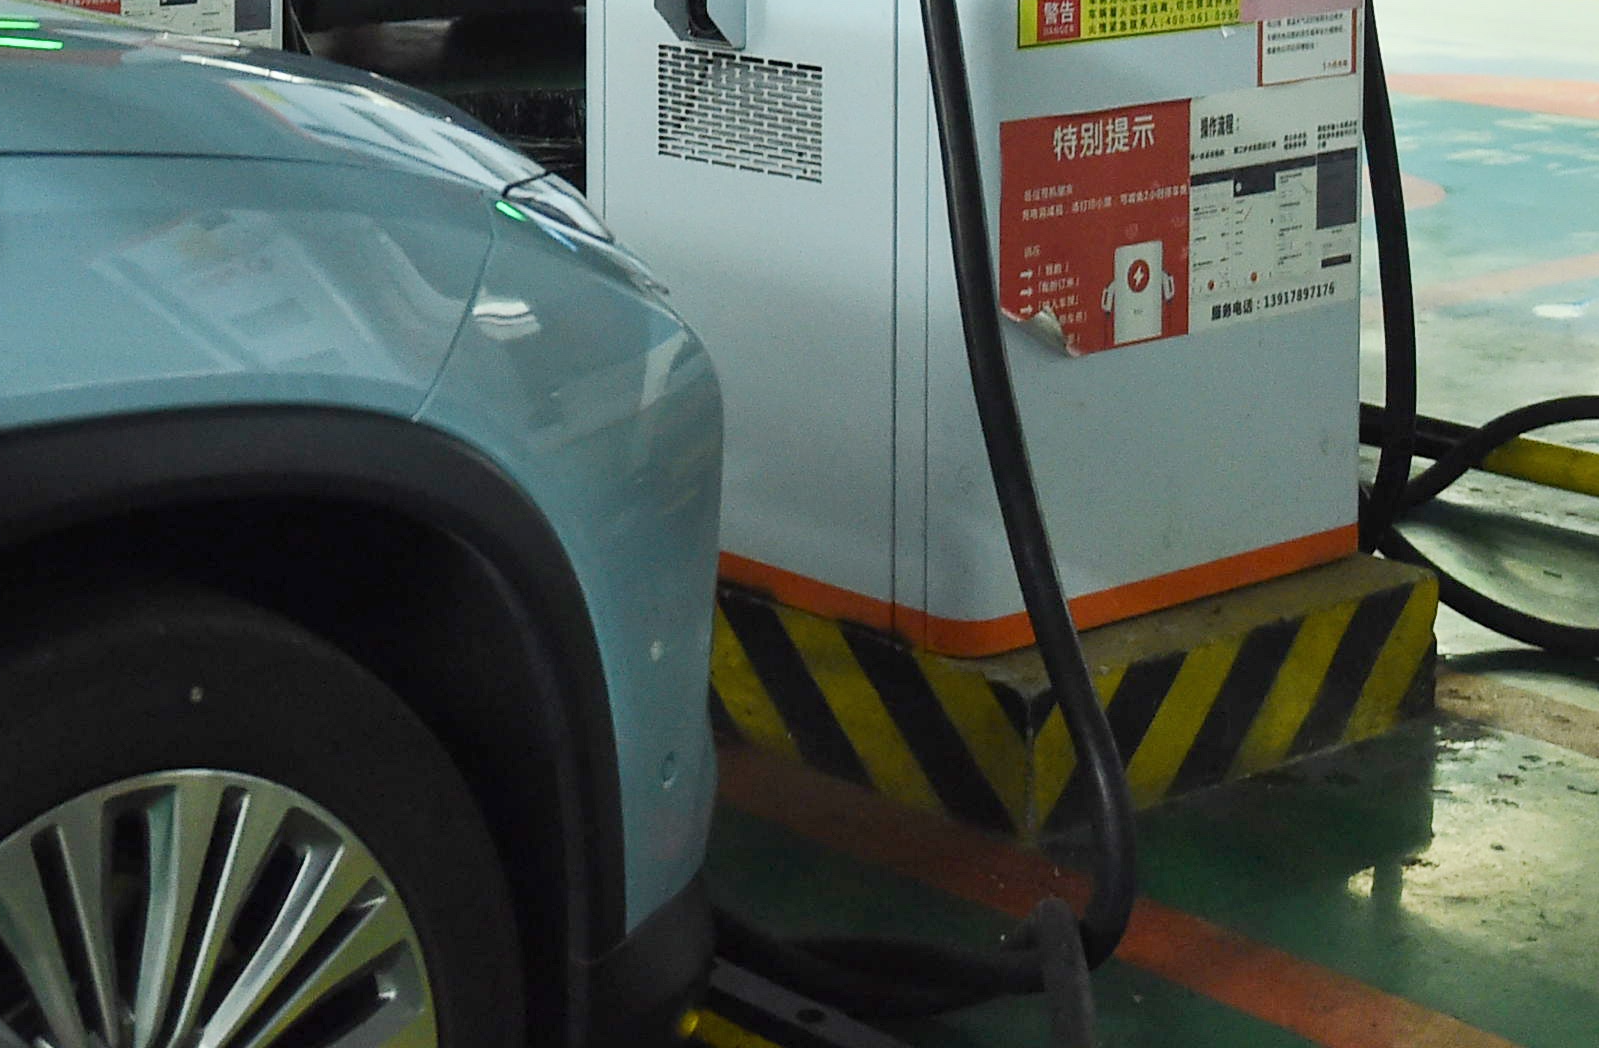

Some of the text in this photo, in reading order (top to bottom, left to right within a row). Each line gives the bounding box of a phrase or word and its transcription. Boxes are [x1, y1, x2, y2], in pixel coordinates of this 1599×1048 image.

[1043, 0, 1076, 26] 警告
[1052, 114, 1156, 162] 特别提示
